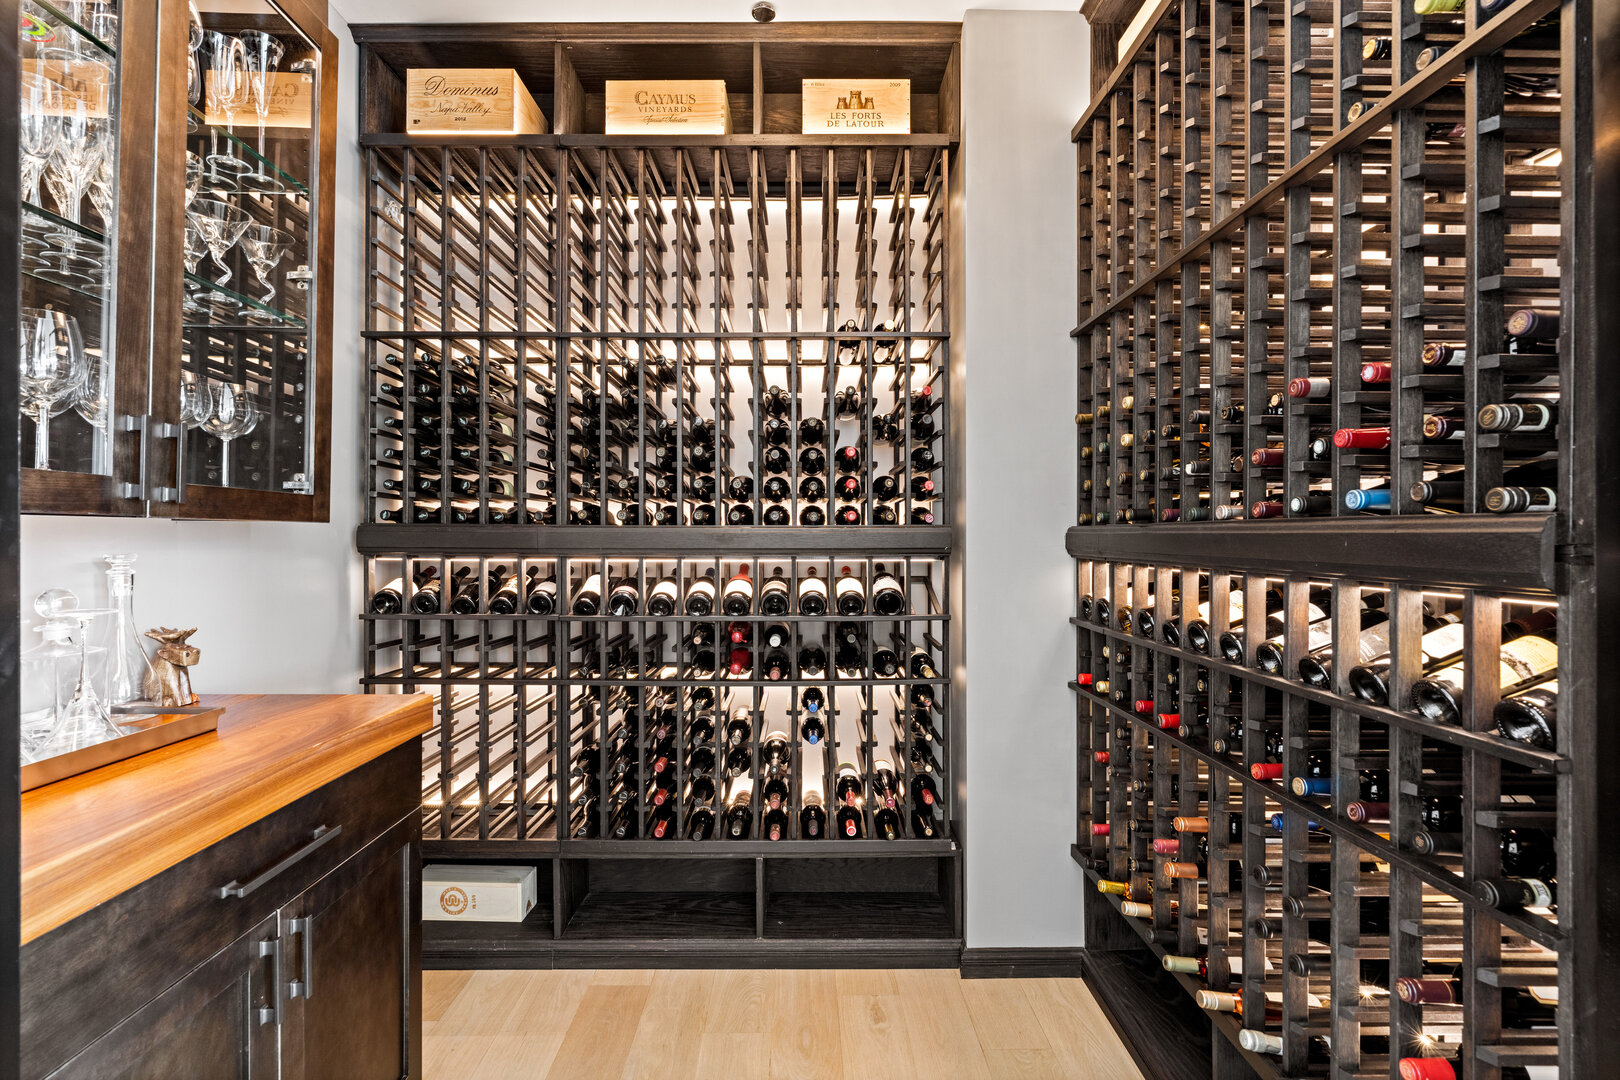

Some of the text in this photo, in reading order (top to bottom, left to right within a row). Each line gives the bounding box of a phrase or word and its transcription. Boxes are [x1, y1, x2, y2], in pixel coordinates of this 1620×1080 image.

[424, 75, 499, 96] Dominus
[634, 90, 696, 105] CAYMUS
[430, 102, 492, 117] Napa Valley
[830, 112, 882, 120] LES FORTS
